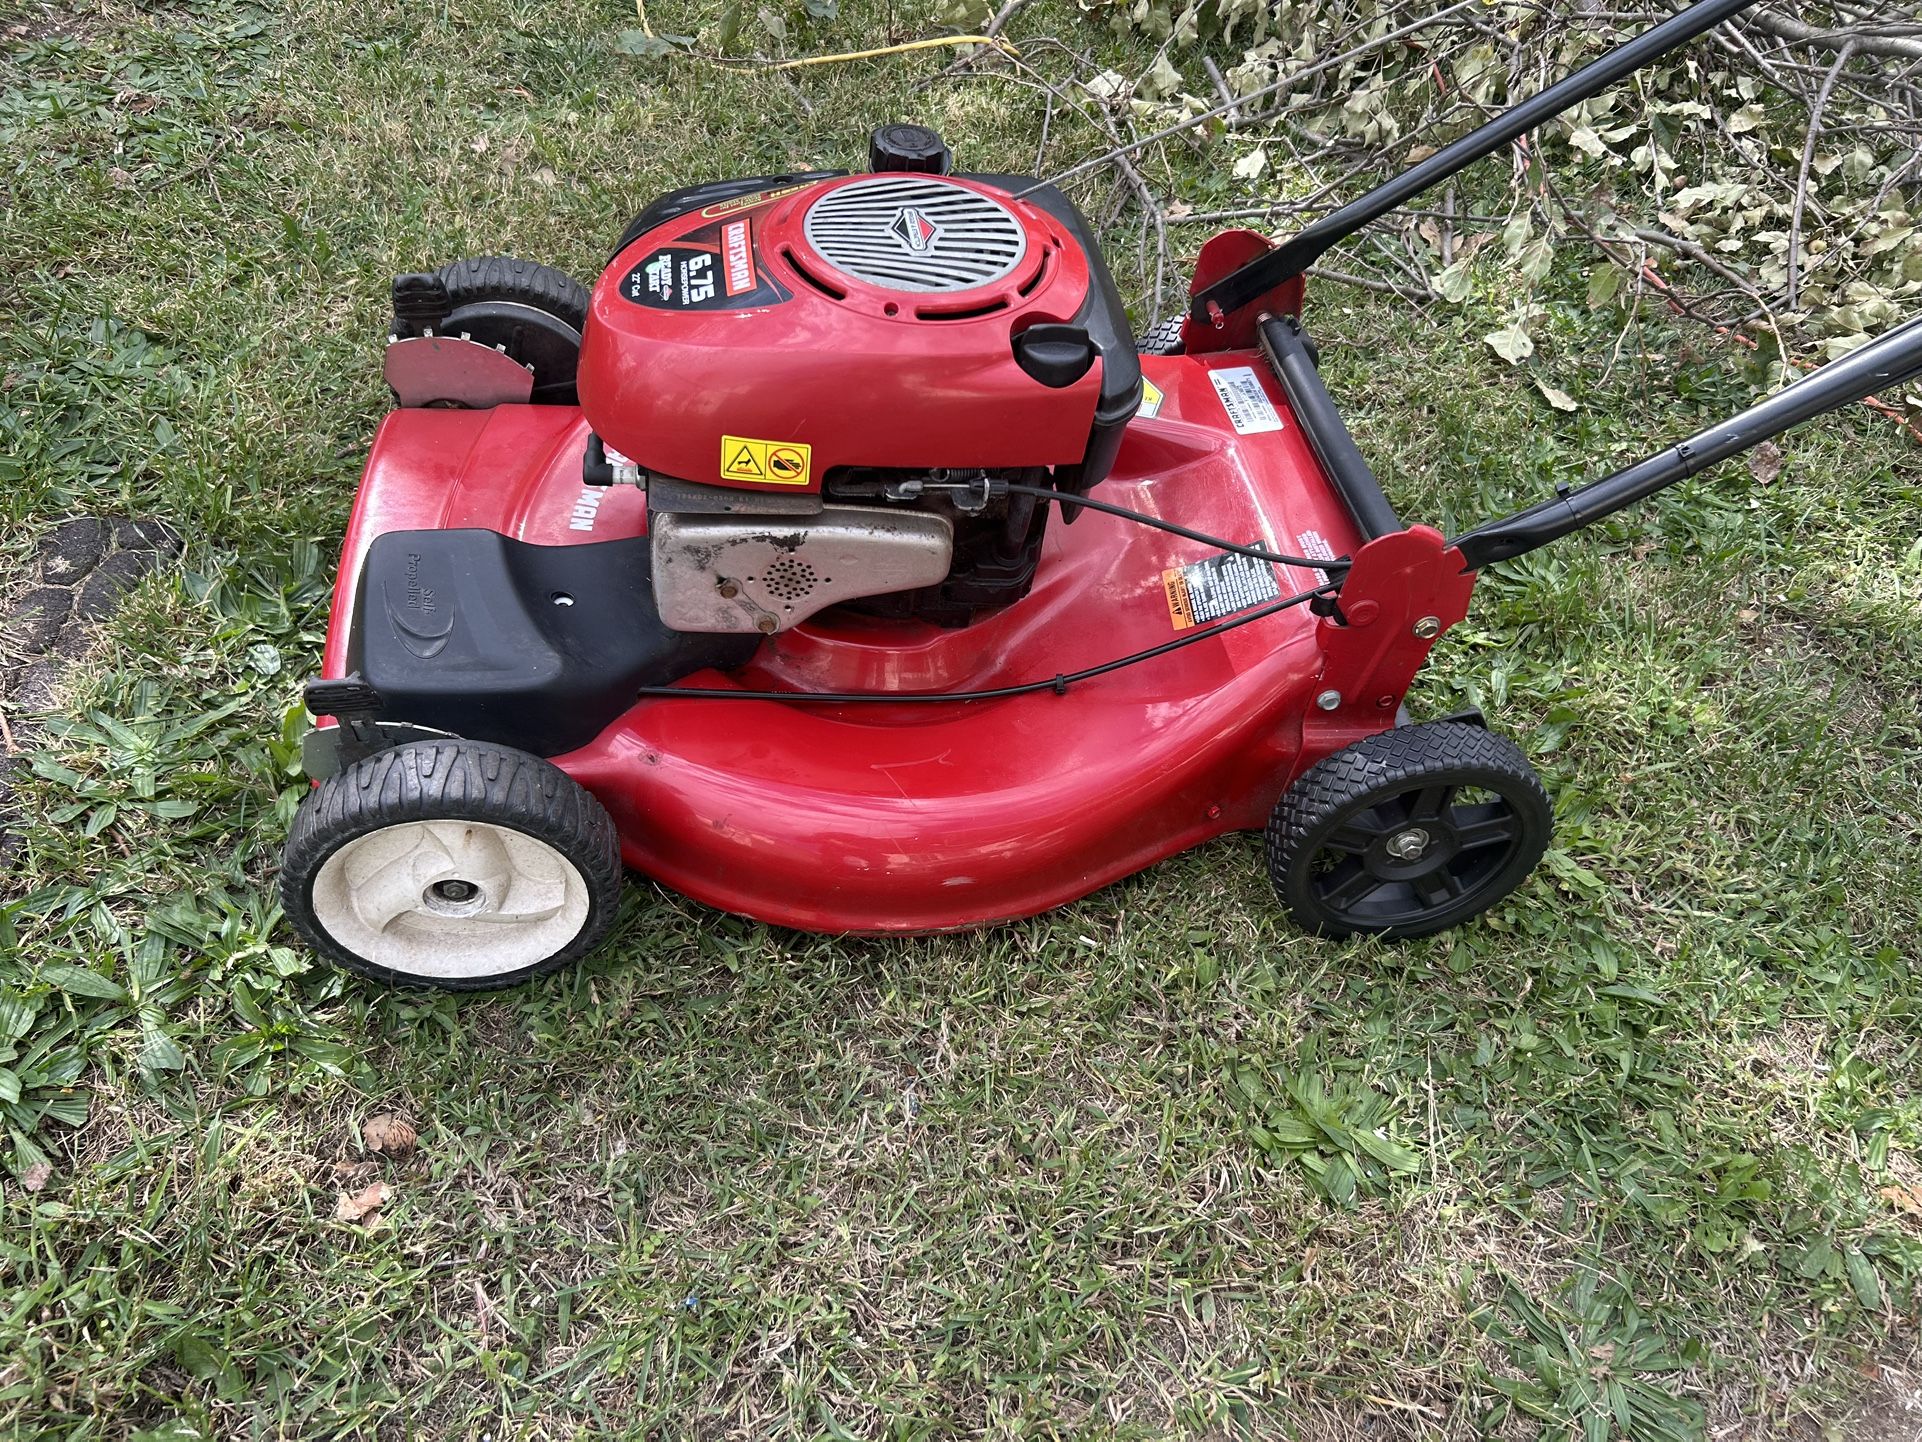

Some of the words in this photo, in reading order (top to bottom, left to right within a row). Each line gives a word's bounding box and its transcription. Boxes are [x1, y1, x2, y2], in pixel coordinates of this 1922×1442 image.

[659, 254, 673, 286] READY
[689, 253, 715, 303] 6.75
[728, 223, 751, 291] CRAFTSMAN
[632, 284, 641, 298] Cut
[680, 261, 690, 305] HORSEPOWER
[1219, 387, 1245, 428] CRAFTSMAN
[404, 553, 421, 609] Propelled
[1167, 581, 1181, 608] WARNING
